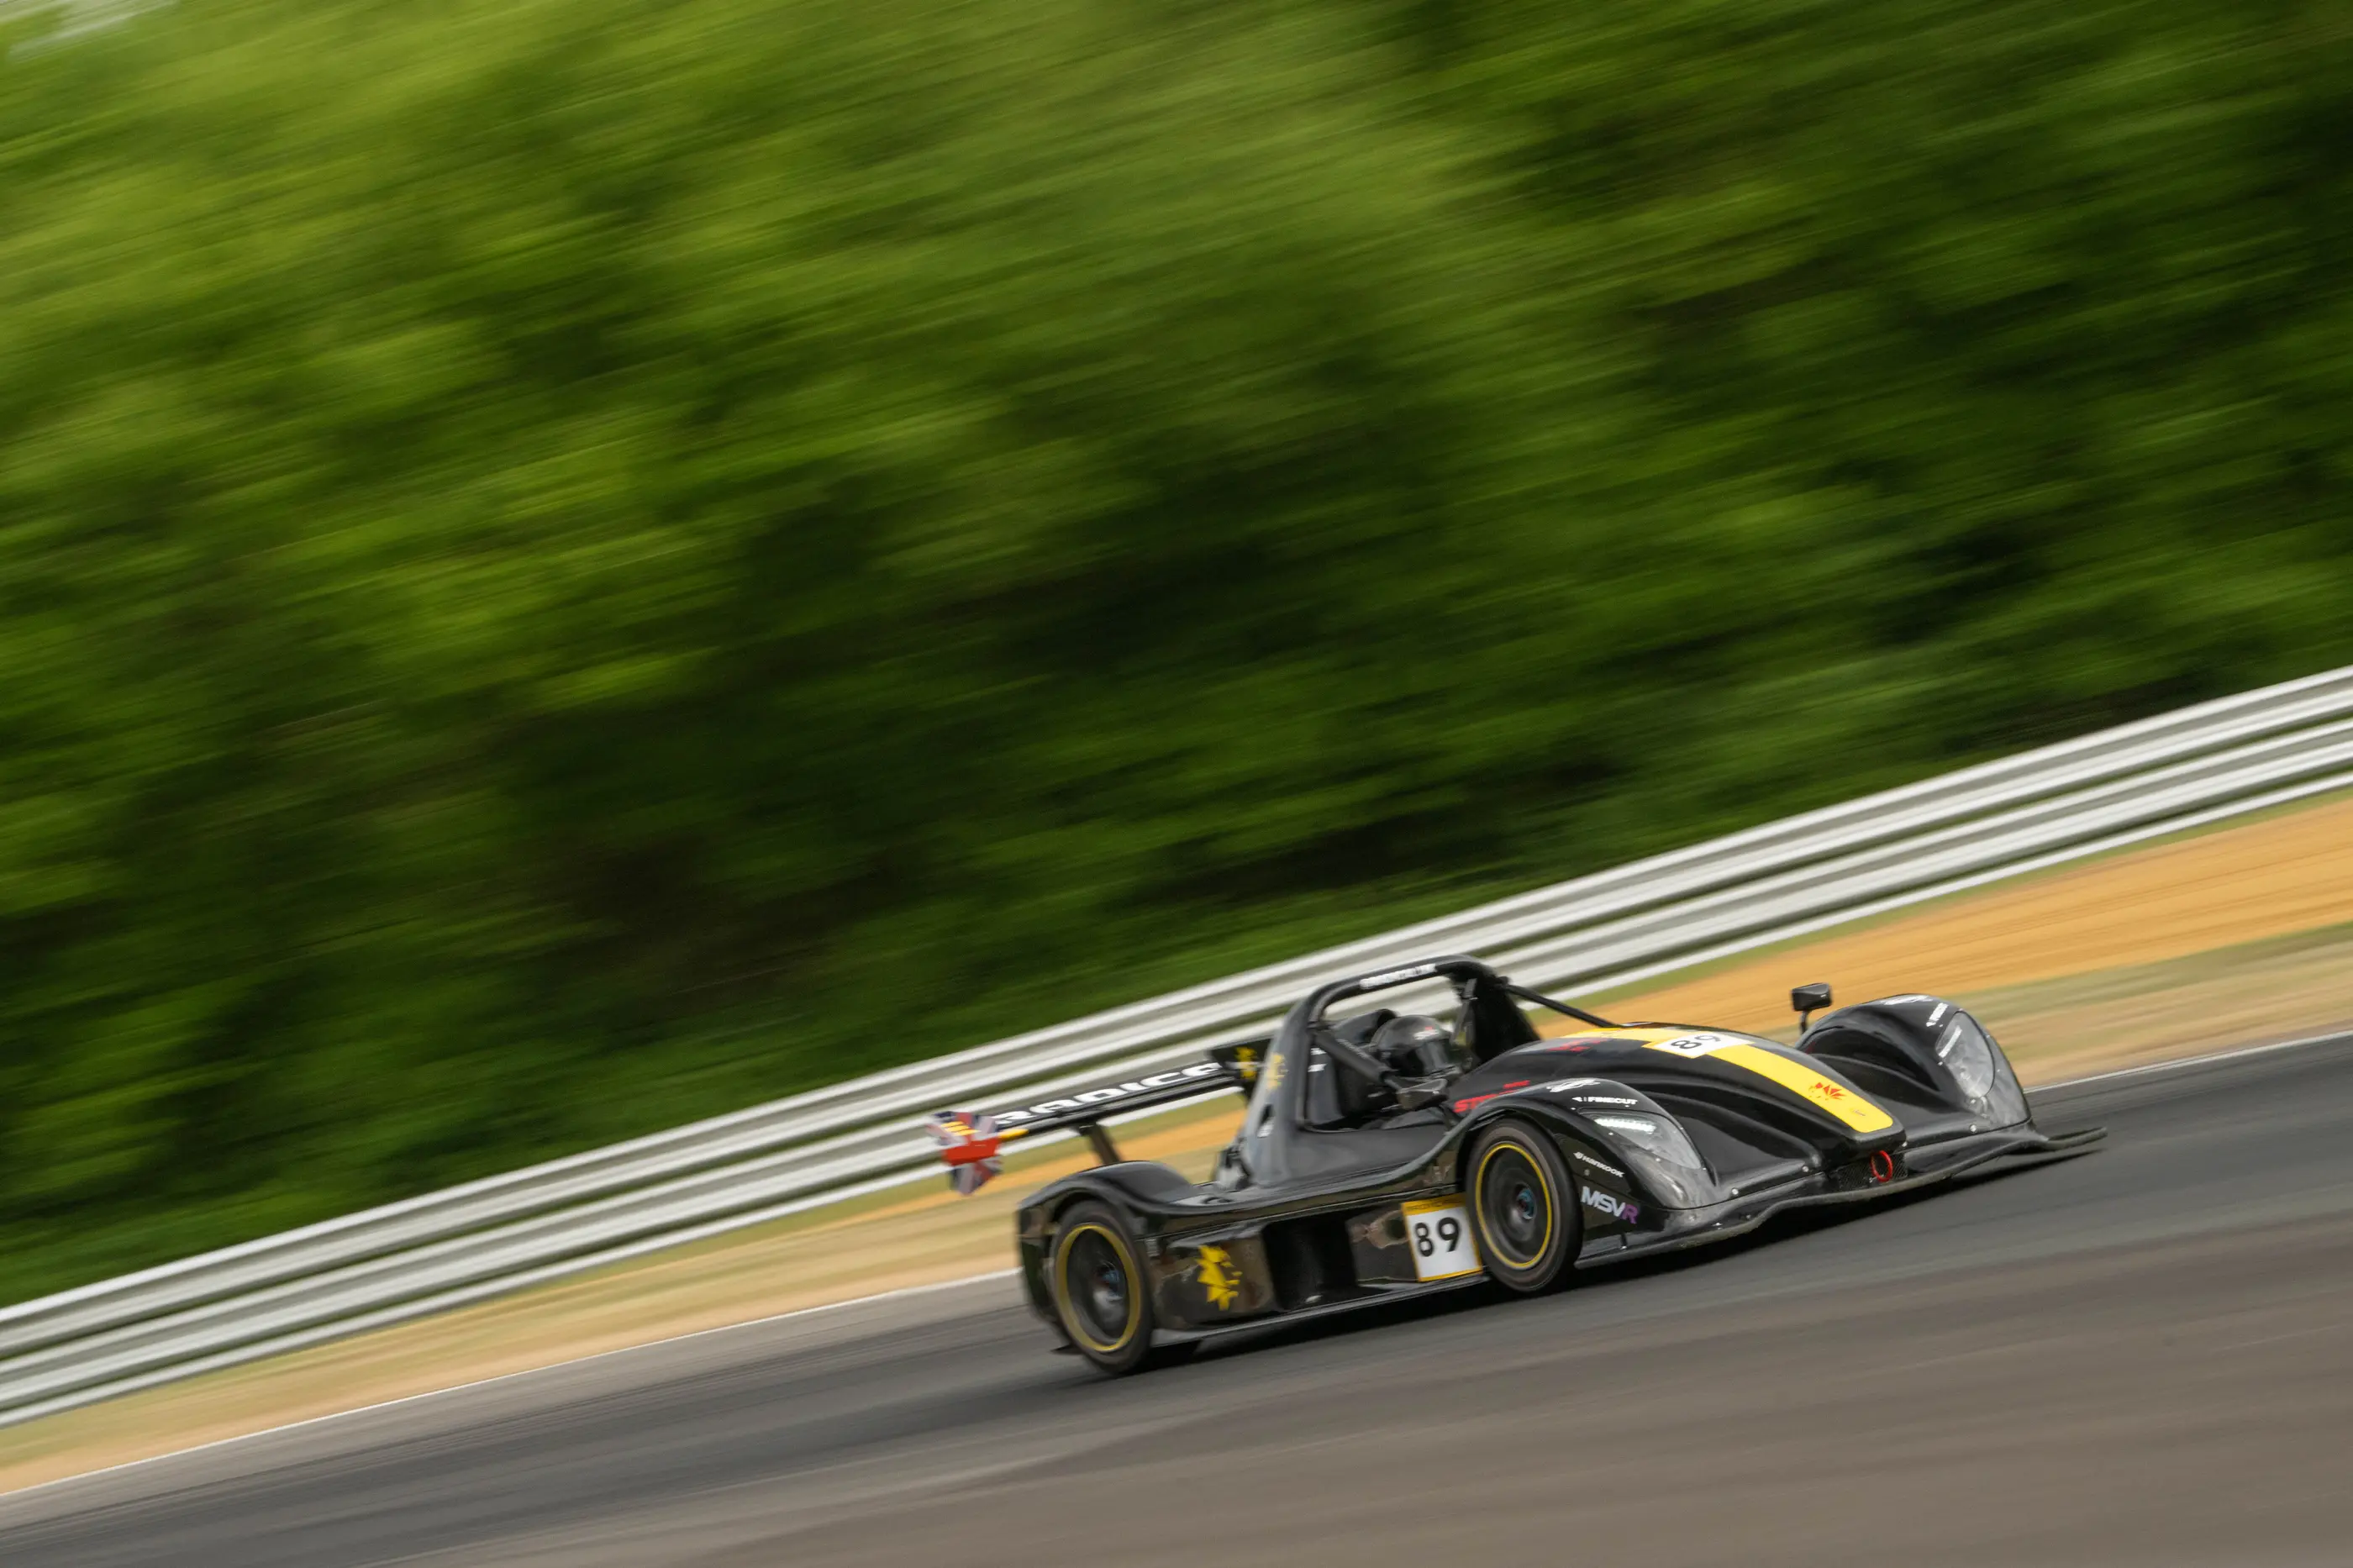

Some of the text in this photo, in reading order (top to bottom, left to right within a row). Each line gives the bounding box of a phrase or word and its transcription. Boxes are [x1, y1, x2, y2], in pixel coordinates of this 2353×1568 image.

[1670, 1034, 1721, 1050] 89
[991, 1062, 1224, 1125] RADICA
[1580, 1186, 1639, 1224] MSVR
[1414, 1217, 1461, 1257] 89
